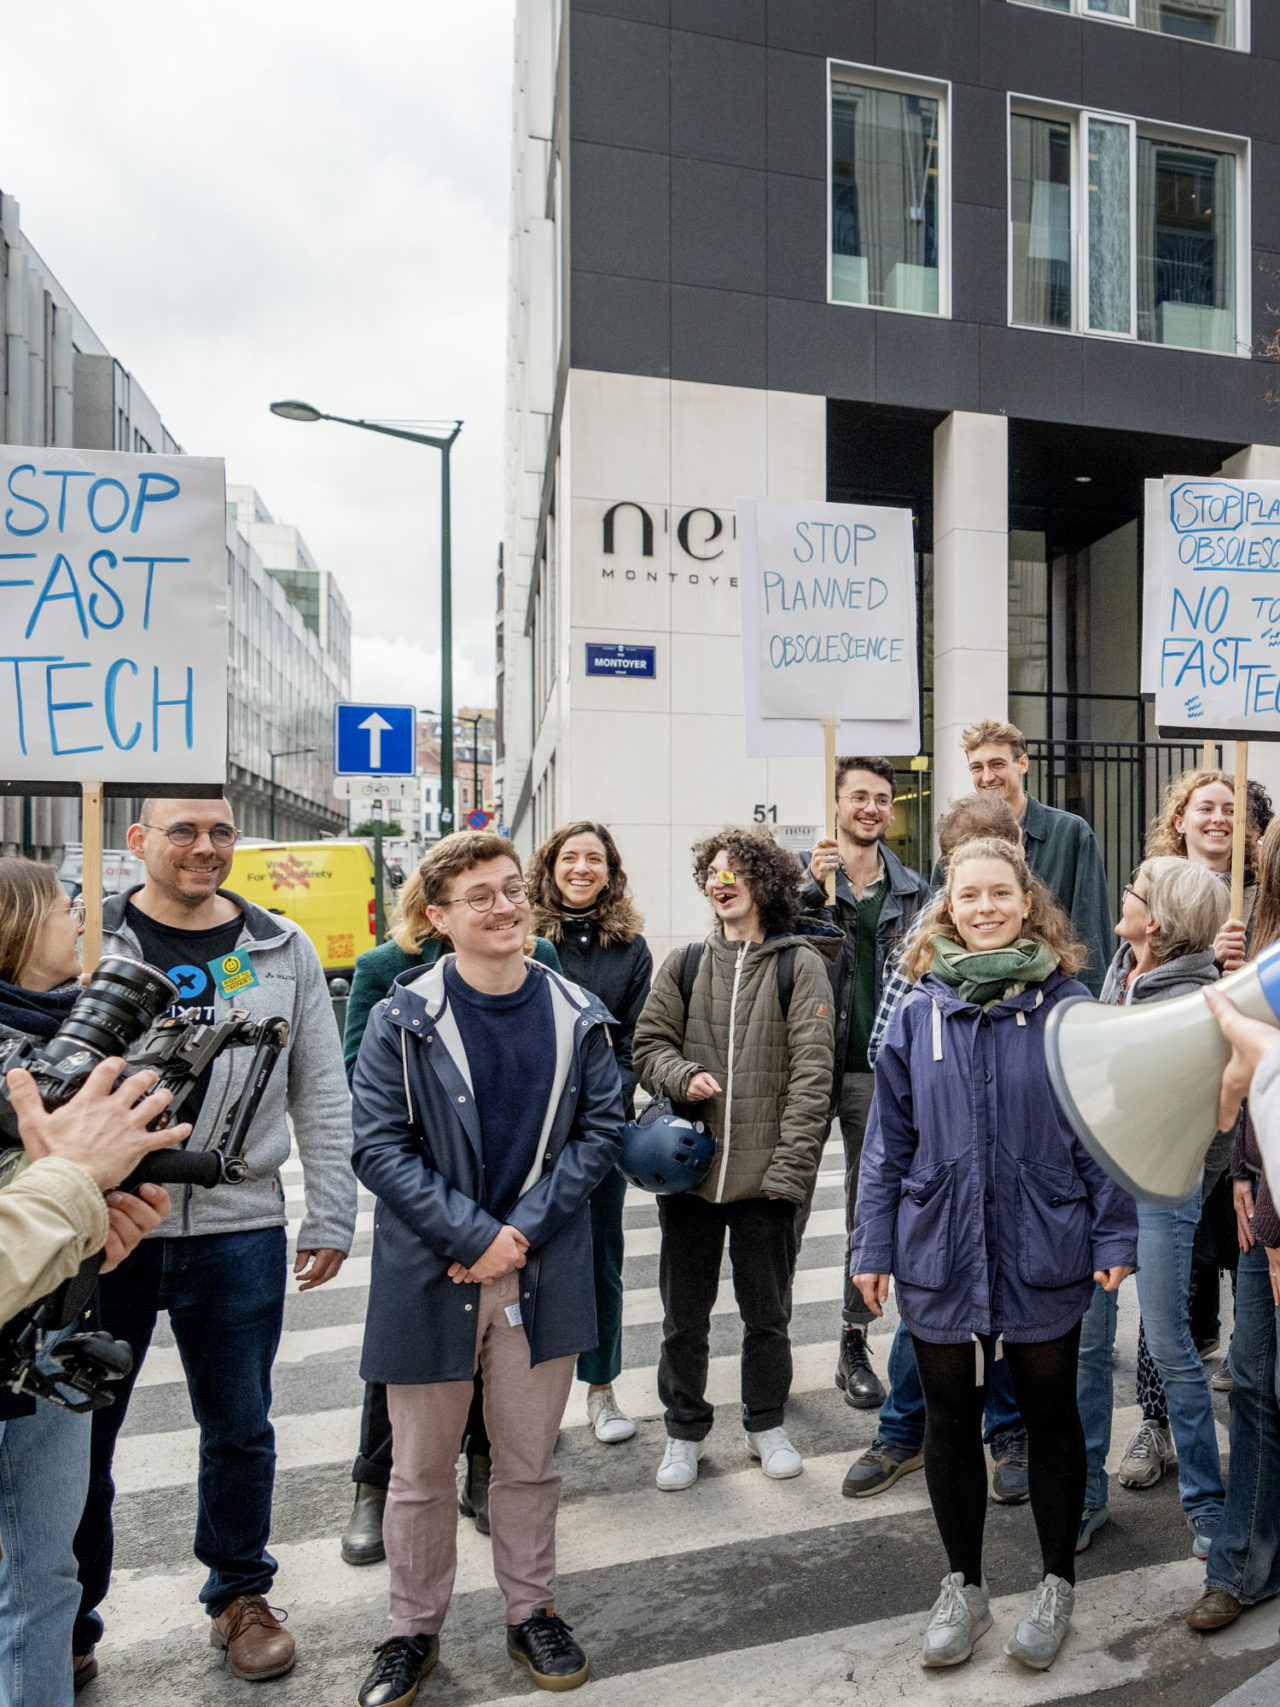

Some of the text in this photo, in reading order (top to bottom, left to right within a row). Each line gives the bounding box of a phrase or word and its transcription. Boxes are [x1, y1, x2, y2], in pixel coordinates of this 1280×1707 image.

[5, 464, 181, 537] STOP
[1176, 489, 1241, 528] STOP
[793, 521, 877, 566] STOP
[602, 568, 738, 588] MONTOYE
[763, 570, 889, 615] PLANNED
[1170, 585, 1229, 634] NO
[594, 658, 648, 669] MONTOYER
[769, 632, 904, 669] OBSOLESCENCE
[1161, 637, 1252, 689] FAST
[0, 656, 193, 756] TECH
[753, 804, 777, 823] 51
[167, 1004, 216, 1020] IXIT
